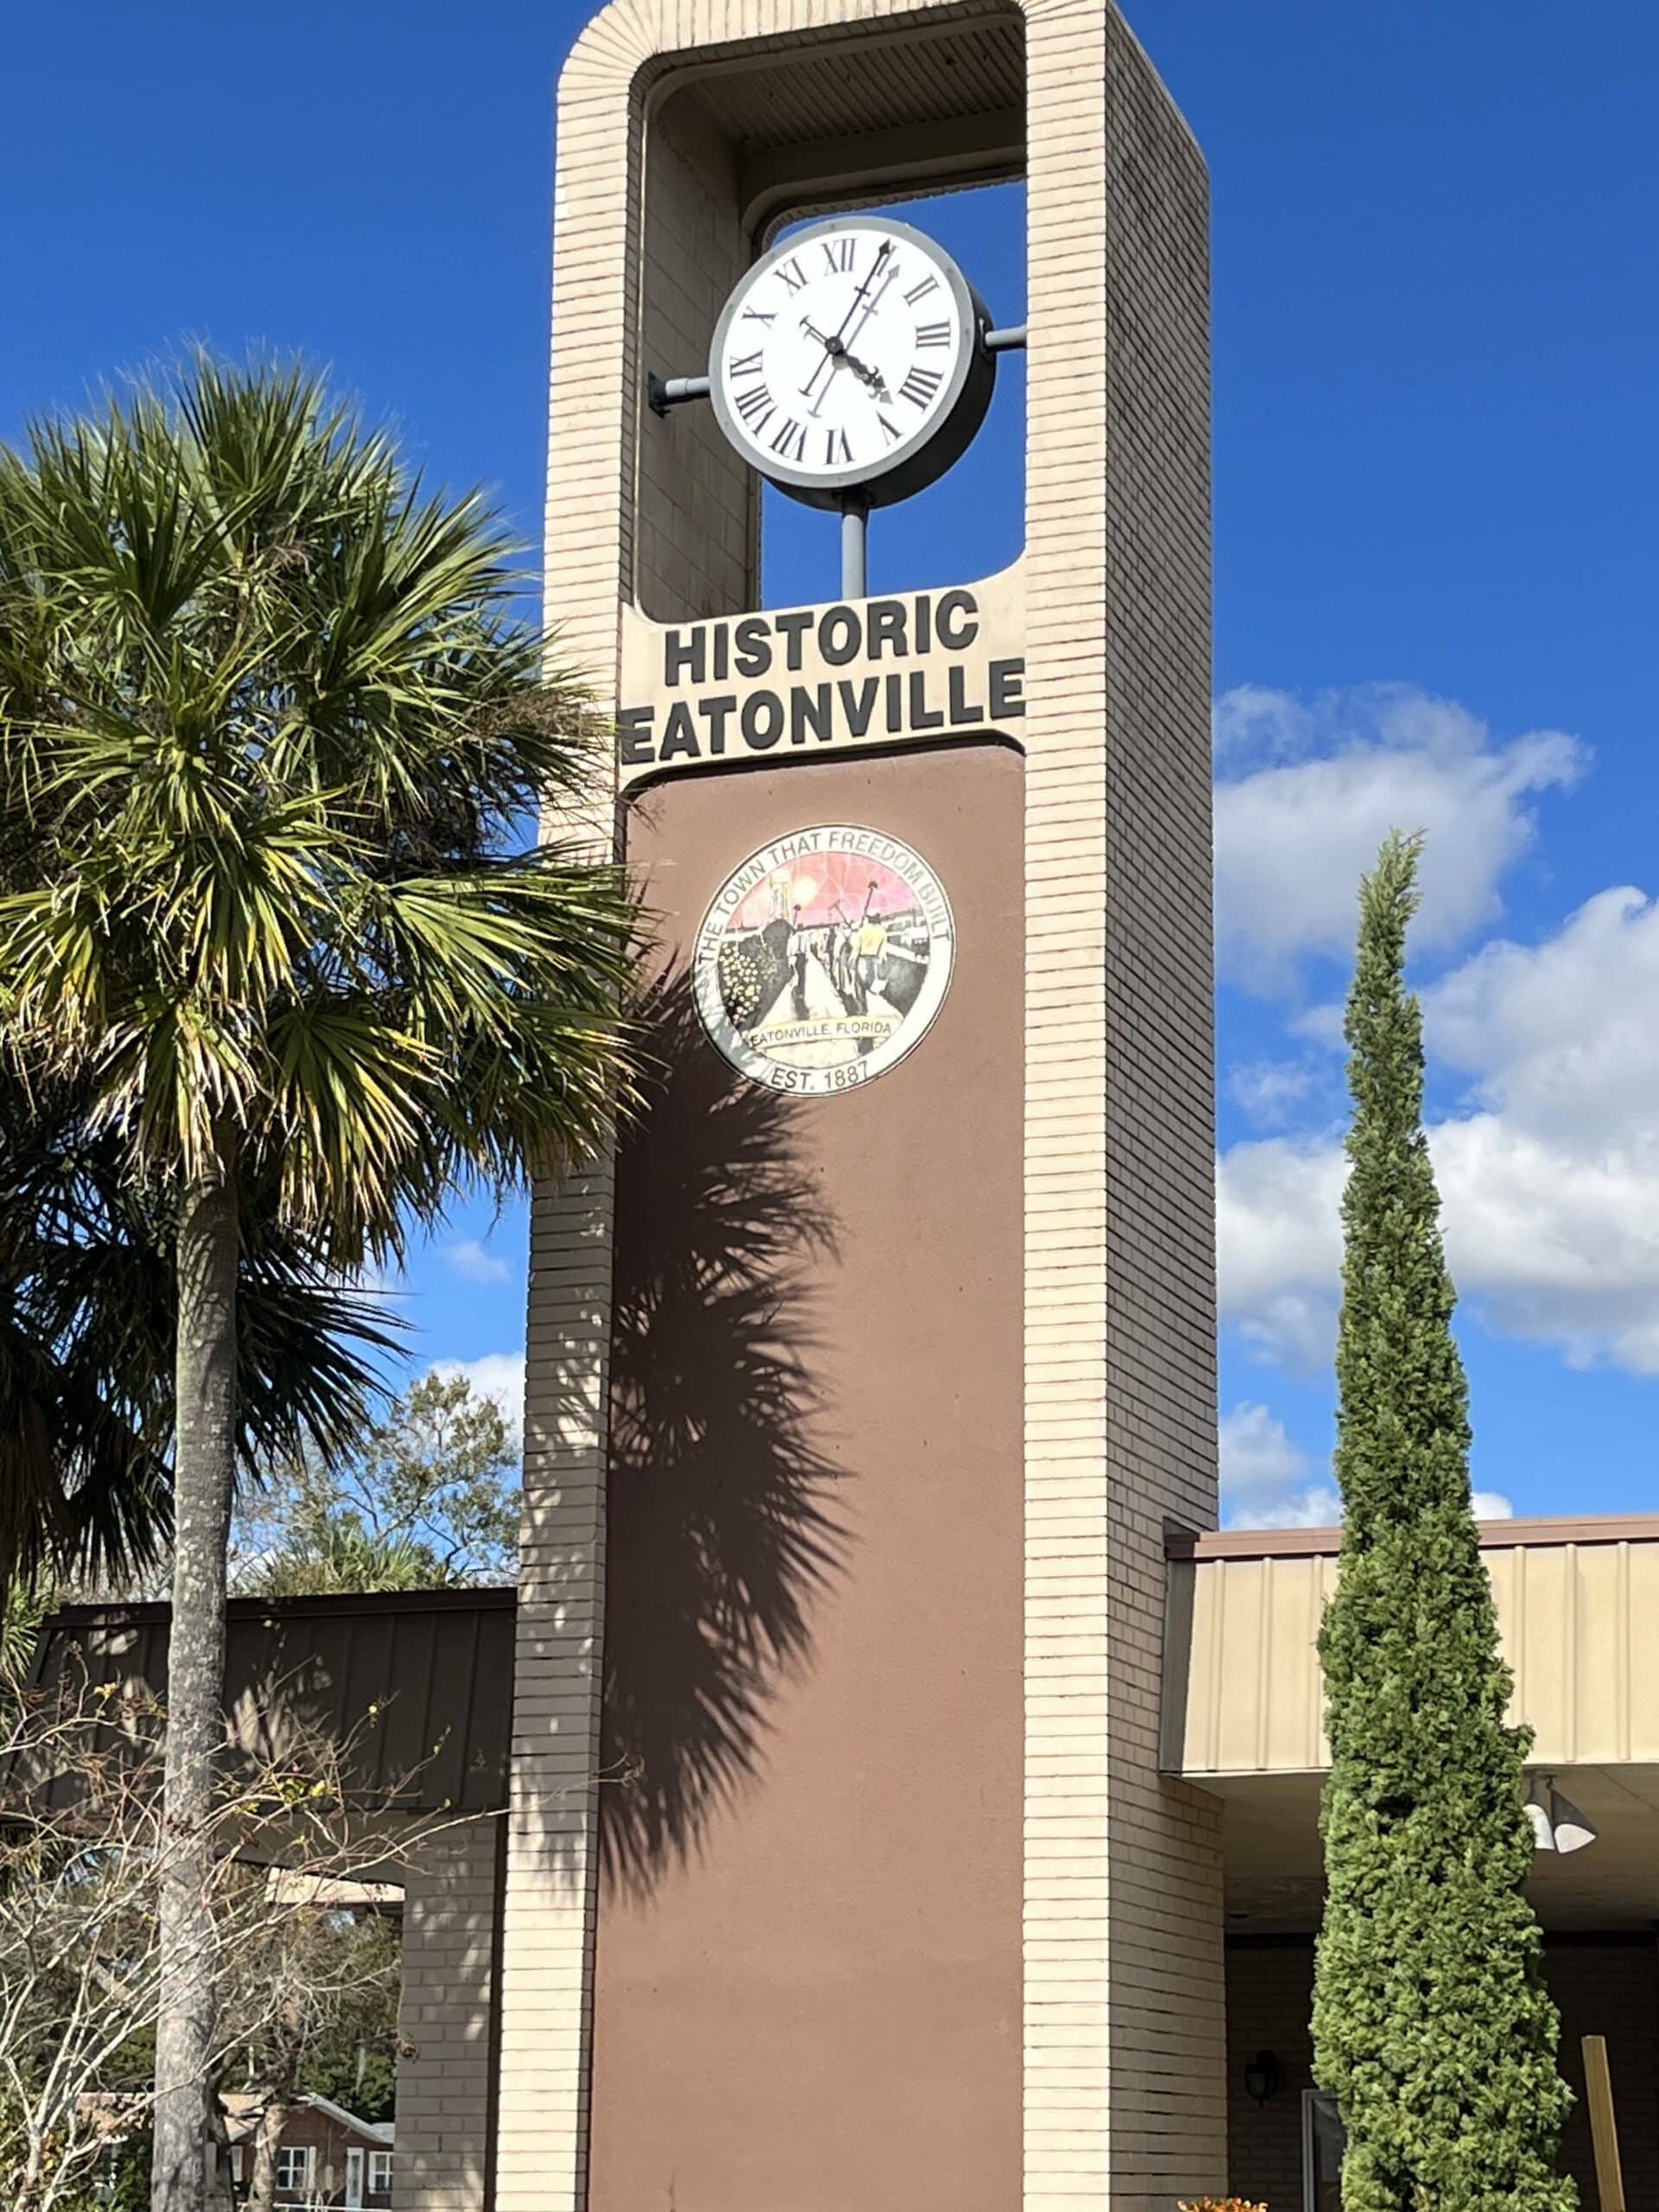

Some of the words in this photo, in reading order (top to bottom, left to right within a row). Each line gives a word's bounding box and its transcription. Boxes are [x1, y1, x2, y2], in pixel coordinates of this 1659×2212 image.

[820, 238, 857, 277] XII
[915, 318, 951, 350] III
[664, 589, 979, 688] HISTORIC
[618, 657, 1027, 766] EATONVILLE
[698, 923, 722, 966] THE
[715, 862, 766, 916] TOWN
[767, 832, 823, 866] THAT
[828, 830, 925, 887] FREEDOM
[919, 884, 951, 942] BUILT
[836, 1020, 892, 1034] FLORIDA
[770, 1066, 816, 1091] EST.
[823, 1059, 868, 1090] 1887
